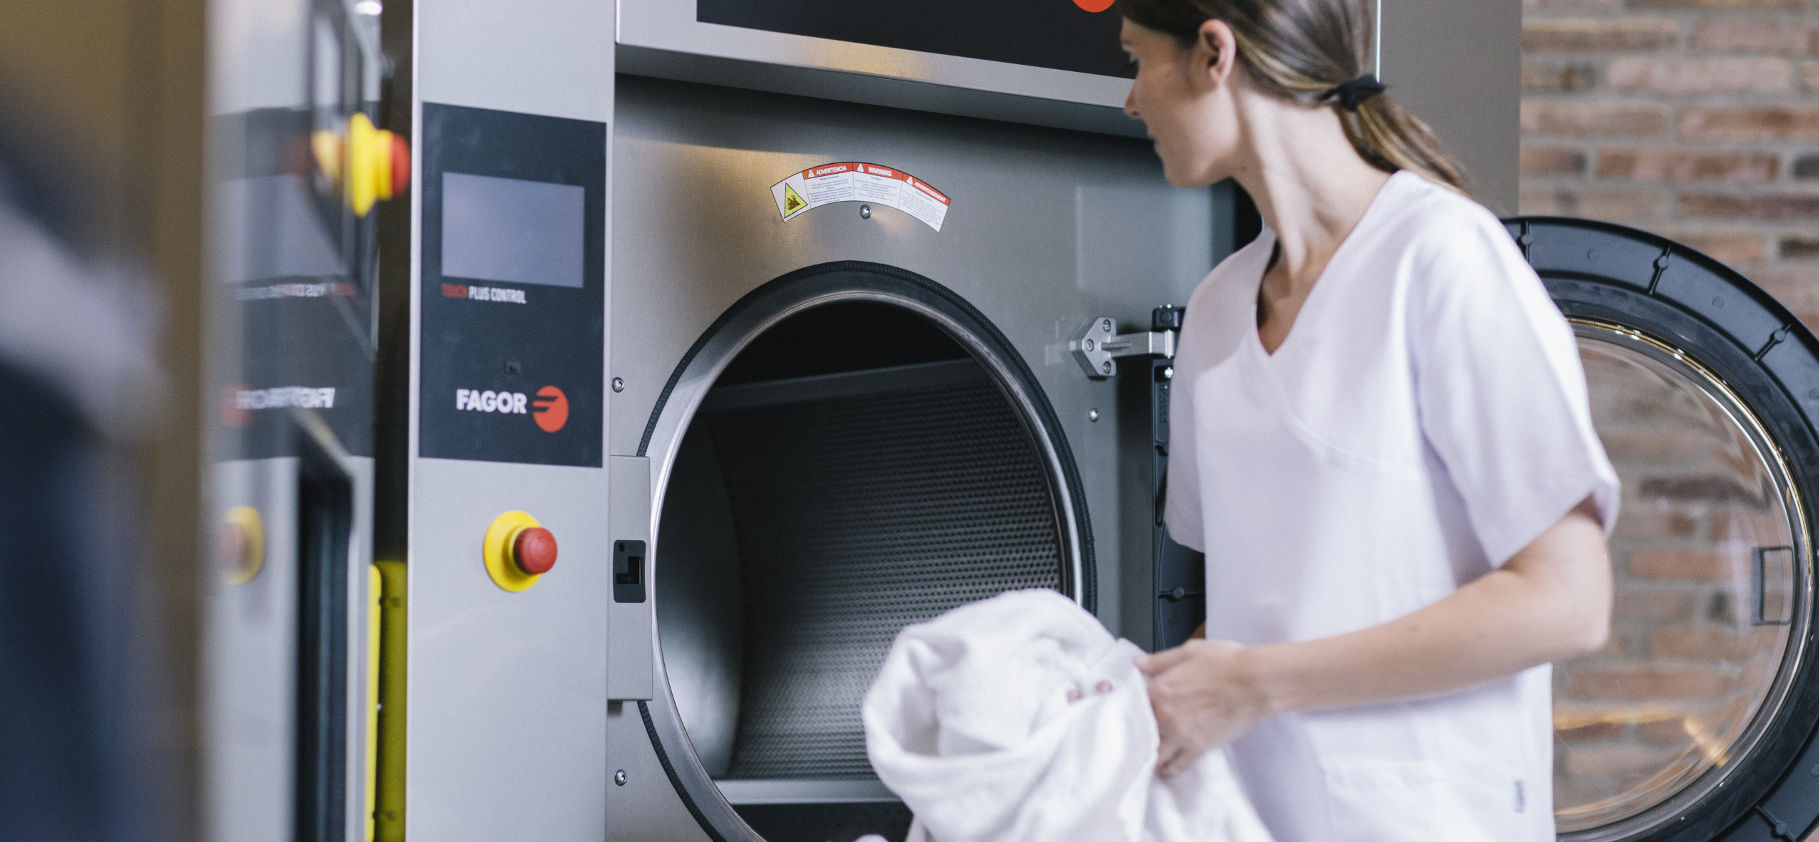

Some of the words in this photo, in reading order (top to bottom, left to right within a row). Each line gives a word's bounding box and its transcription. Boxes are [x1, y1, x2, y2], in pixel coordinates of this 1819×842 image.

[816, 165, 847, 175] ADVERTENCIA
[868, 166, 892, 177] WARNING
[469, 286, 490, 301] PLUS
[490, 287, 527, 304] CONTROL
[456, 388, 528, 414] FAGOR
